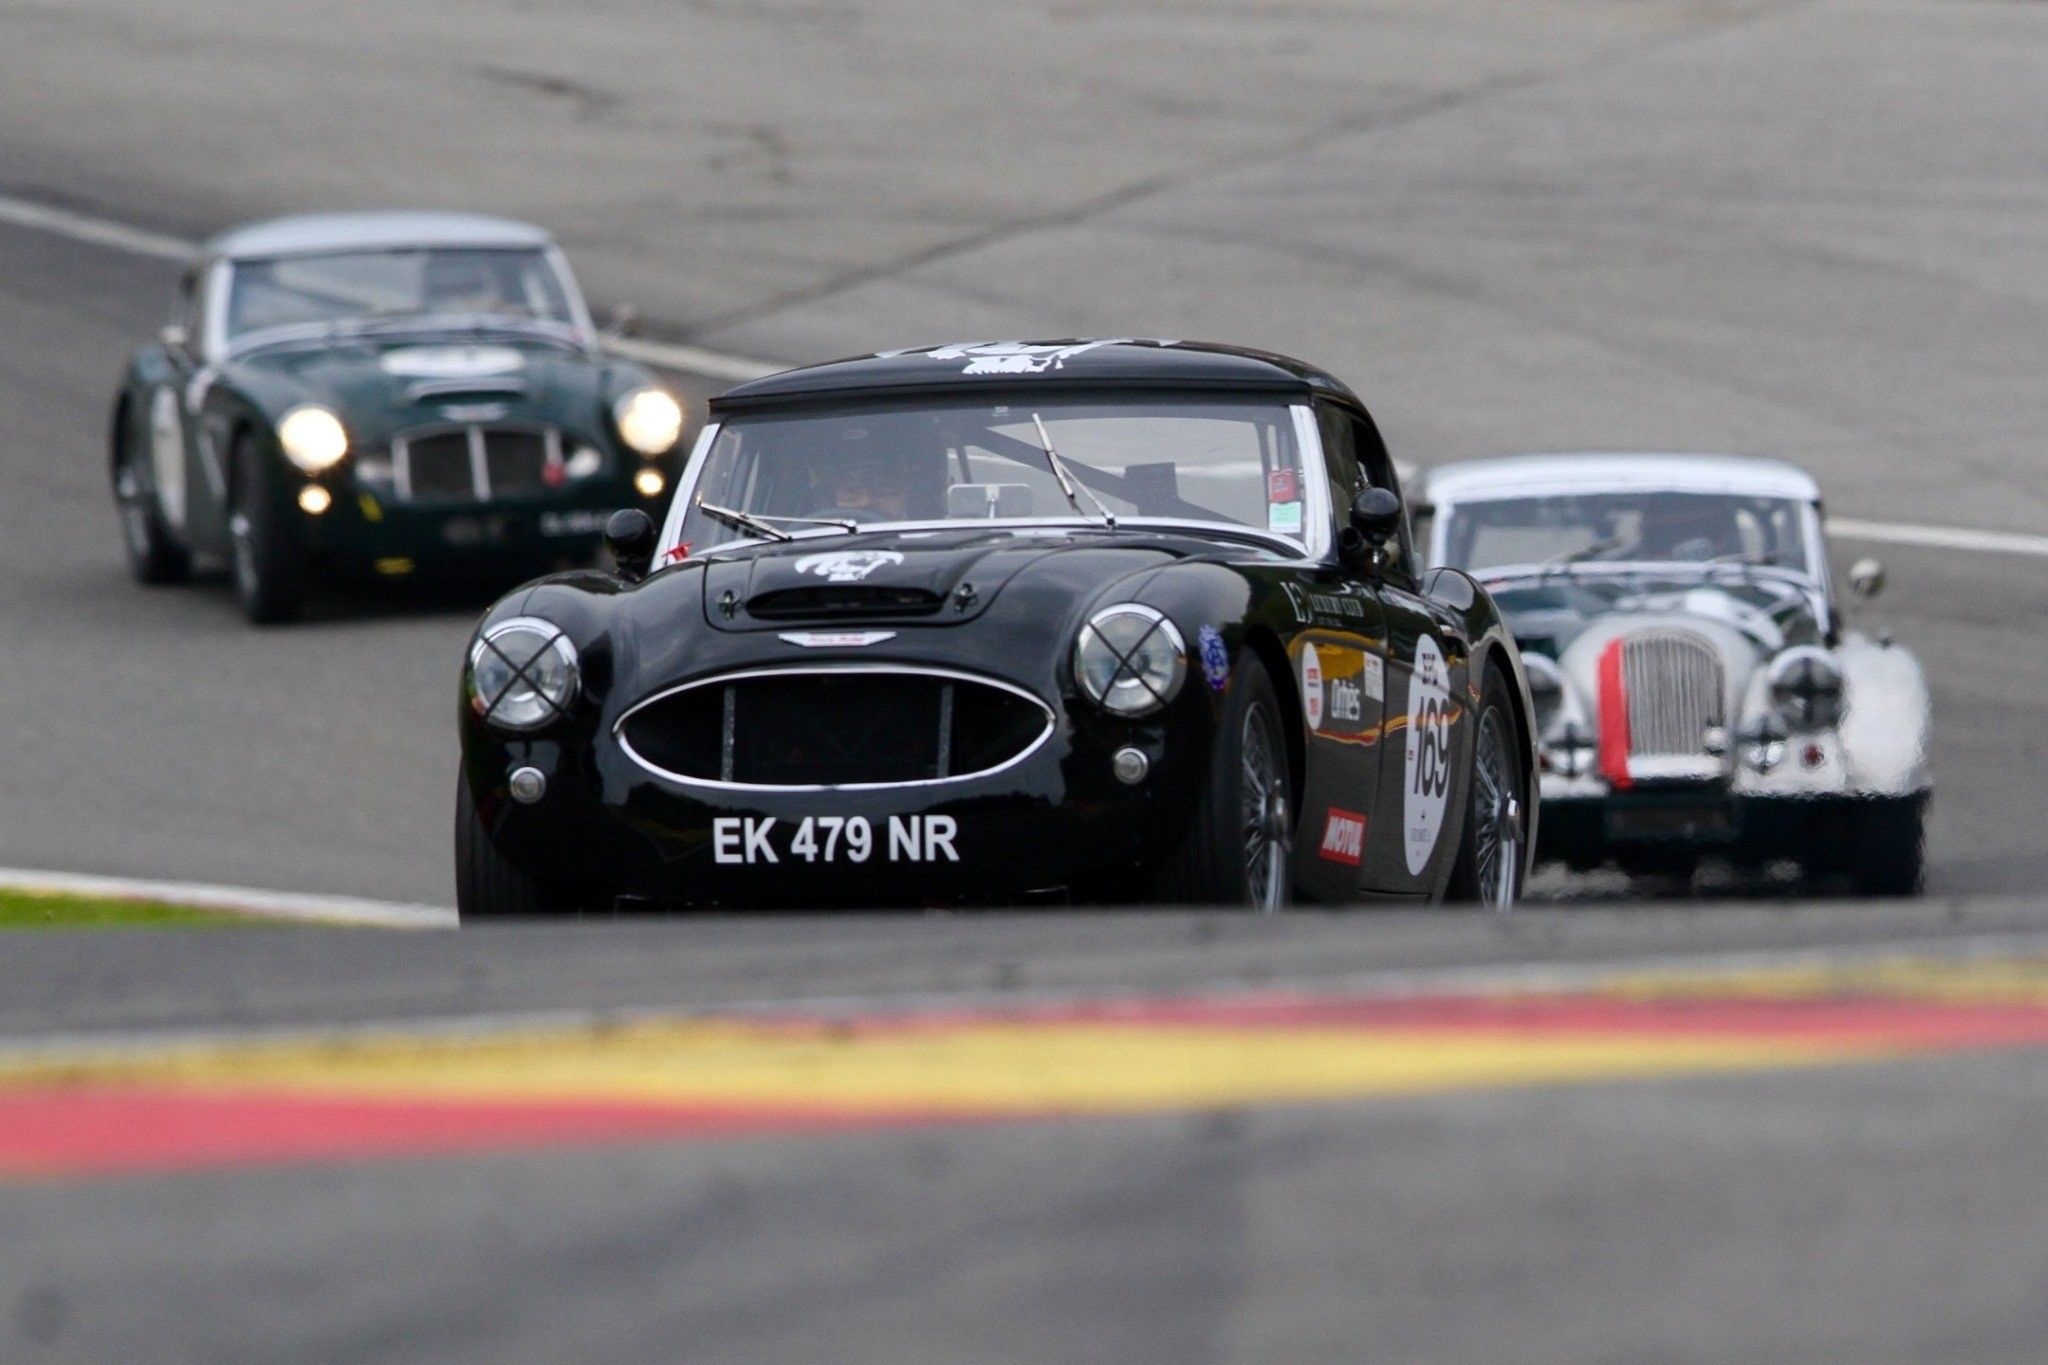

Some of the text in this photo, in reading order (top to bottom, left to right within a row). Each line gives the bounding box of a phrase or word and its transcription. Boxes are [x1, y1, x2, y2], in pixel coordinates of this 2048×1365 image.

[1414, 697, 1449, 799] 169
[713, 815, 960, 863] EK 479 NR
[1322, 815, 1362, 857] MOTUL
